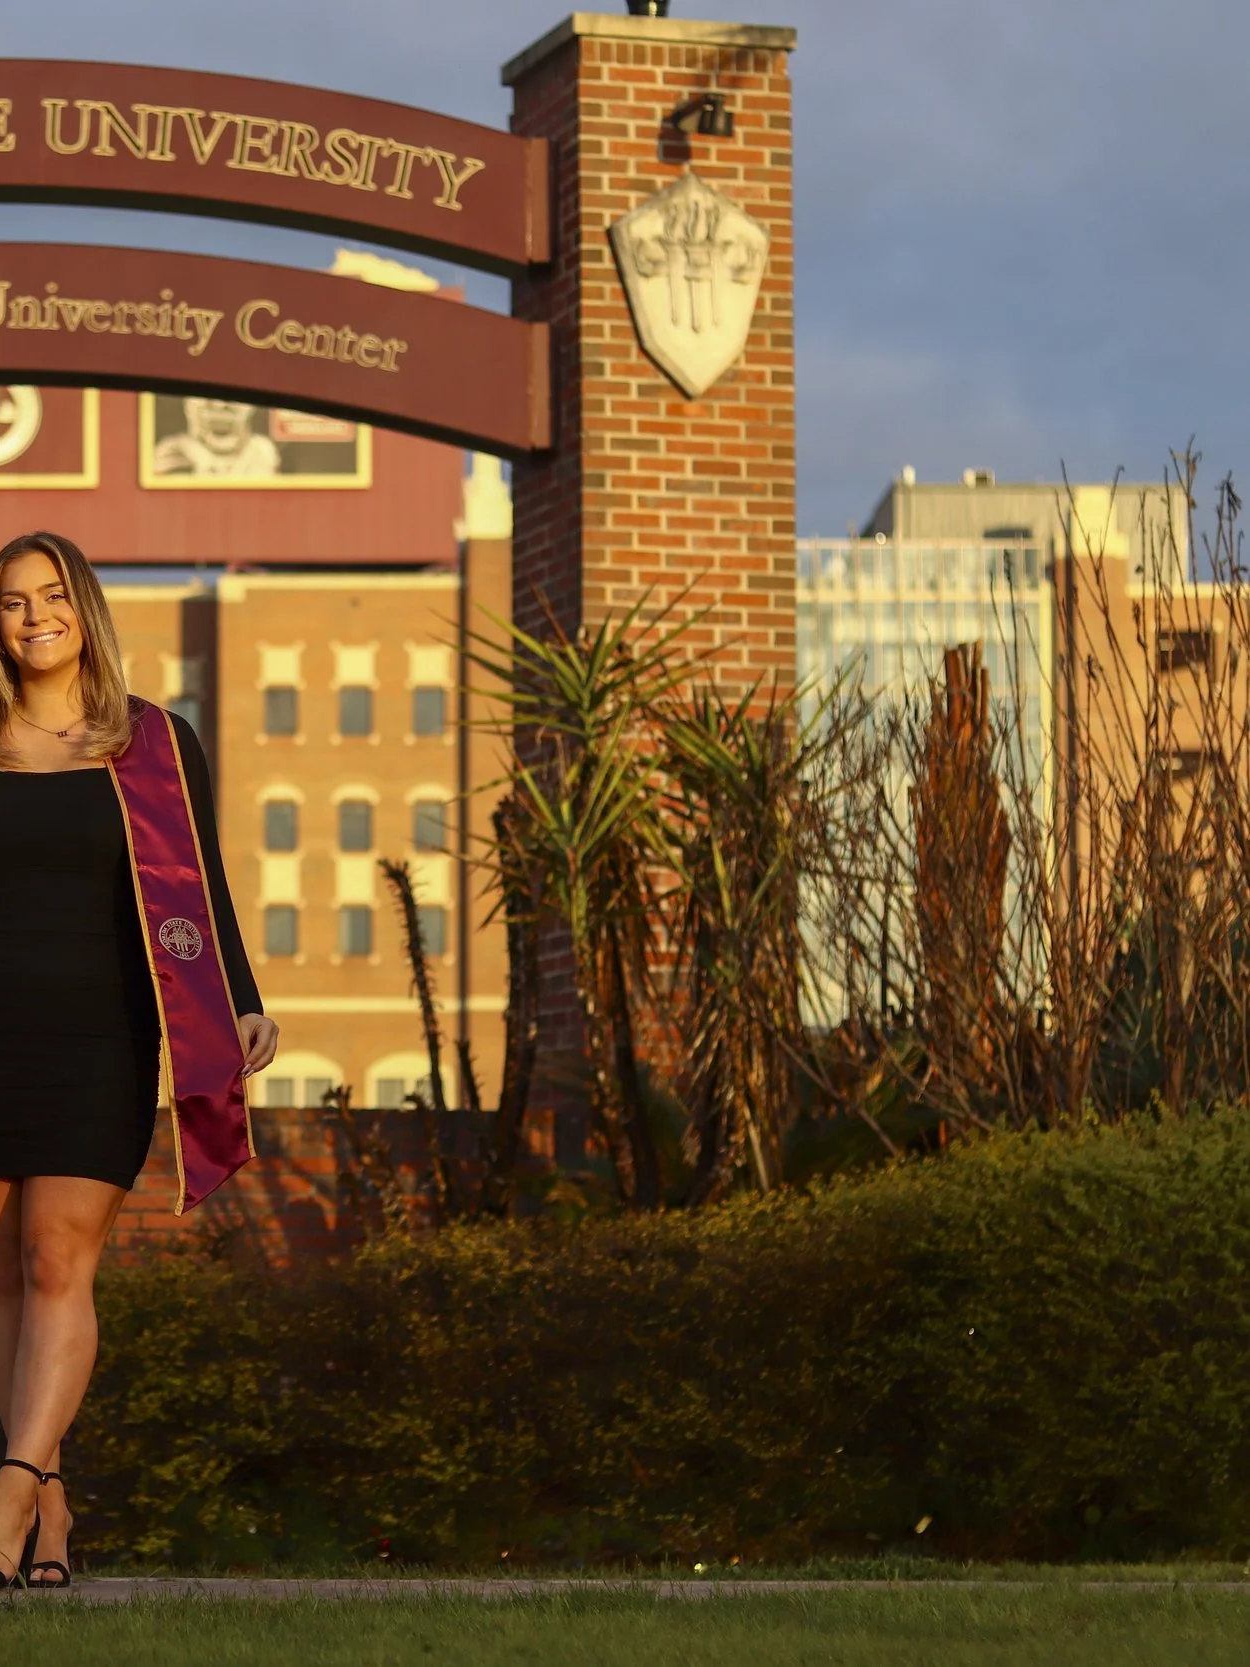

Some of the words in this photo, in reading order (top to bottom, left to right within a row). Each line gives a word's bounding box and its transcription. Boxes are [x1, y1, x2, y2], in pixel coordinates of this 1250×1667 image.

[41, 98, 486, 212] UNIVERSITY
[235, 299, 408, 373] Center
[167, 920, 181, 928] STATE
